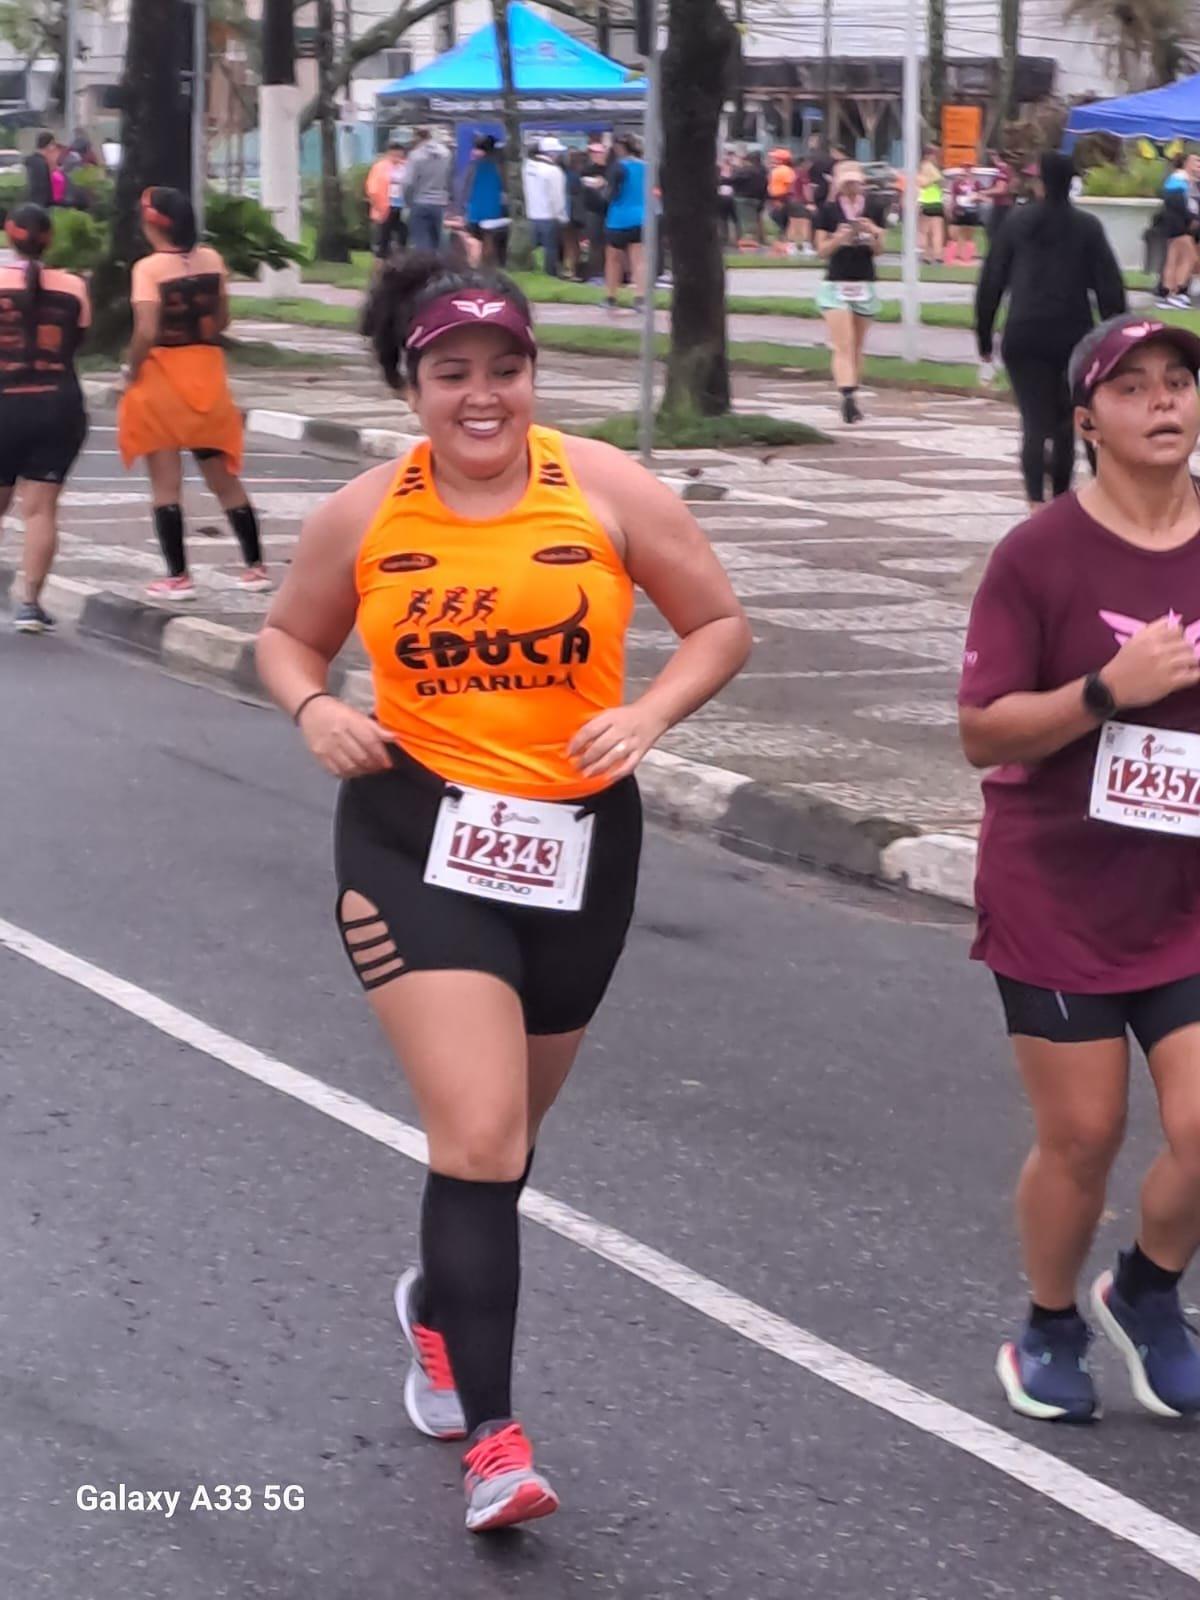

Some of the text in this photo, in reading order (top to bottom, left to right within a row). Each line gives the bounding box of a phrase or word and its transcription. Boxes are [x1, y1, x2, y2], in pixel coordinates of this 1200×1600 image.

[395, 627, 591, 670] EDUCA
[1111, 758, 1200, 805] 12357
[454, 824, 560, 877] 12343
